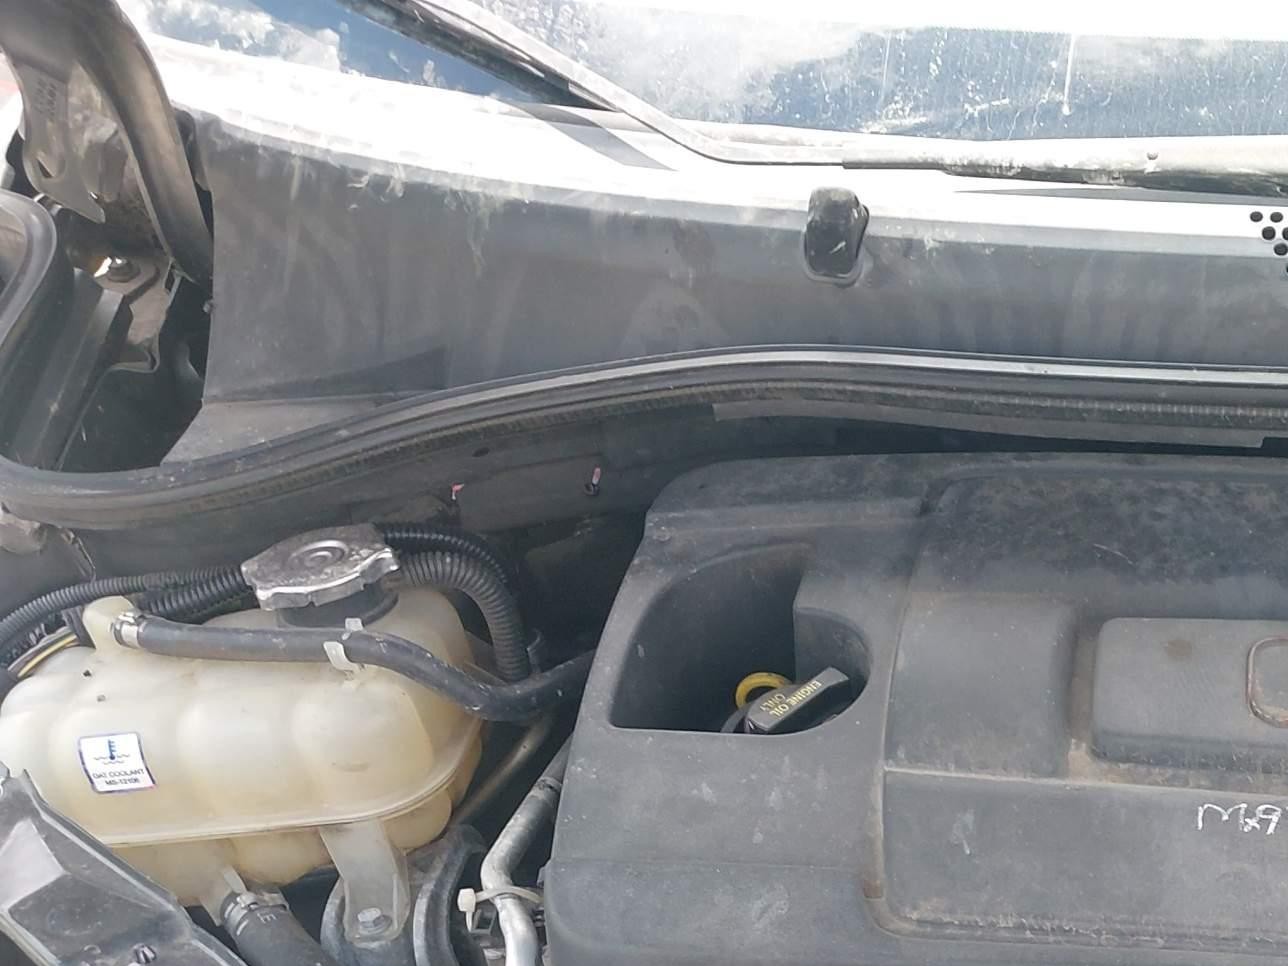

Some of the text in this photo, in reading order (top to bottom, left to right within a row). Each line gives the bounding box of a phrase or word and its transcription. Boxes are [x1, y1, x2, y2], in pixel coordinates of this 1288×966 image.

[769, 680, 822, 717] ENGINE OIL
[108, 768, 144, 778] COOLANT
